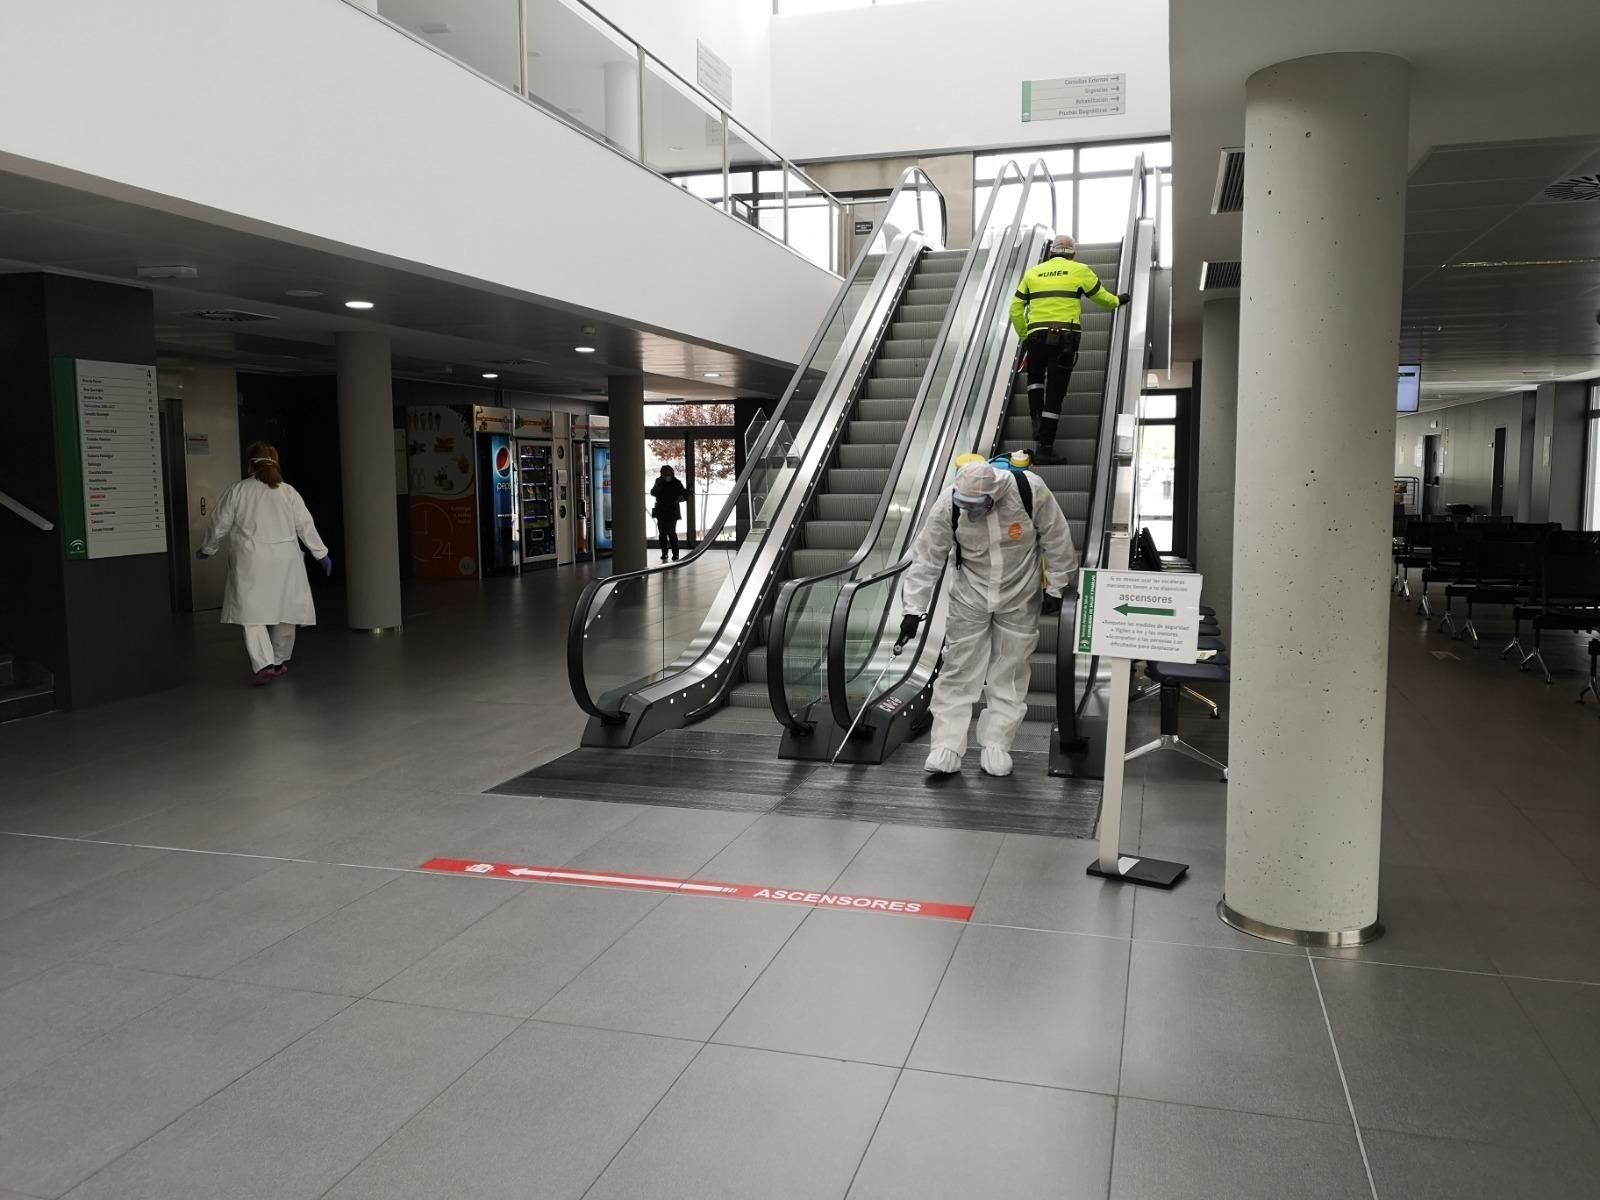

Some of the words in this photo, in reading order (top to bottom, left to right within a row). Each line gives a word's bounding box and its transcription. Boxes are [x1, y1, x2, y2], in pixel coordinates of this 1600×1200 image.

[146, 369, 151, 379] 4
[431, 538, 453, 560] 24
[1119, 593, 1173, 604] ascensores
[753, 888, 921, 912] ASCENSORES
